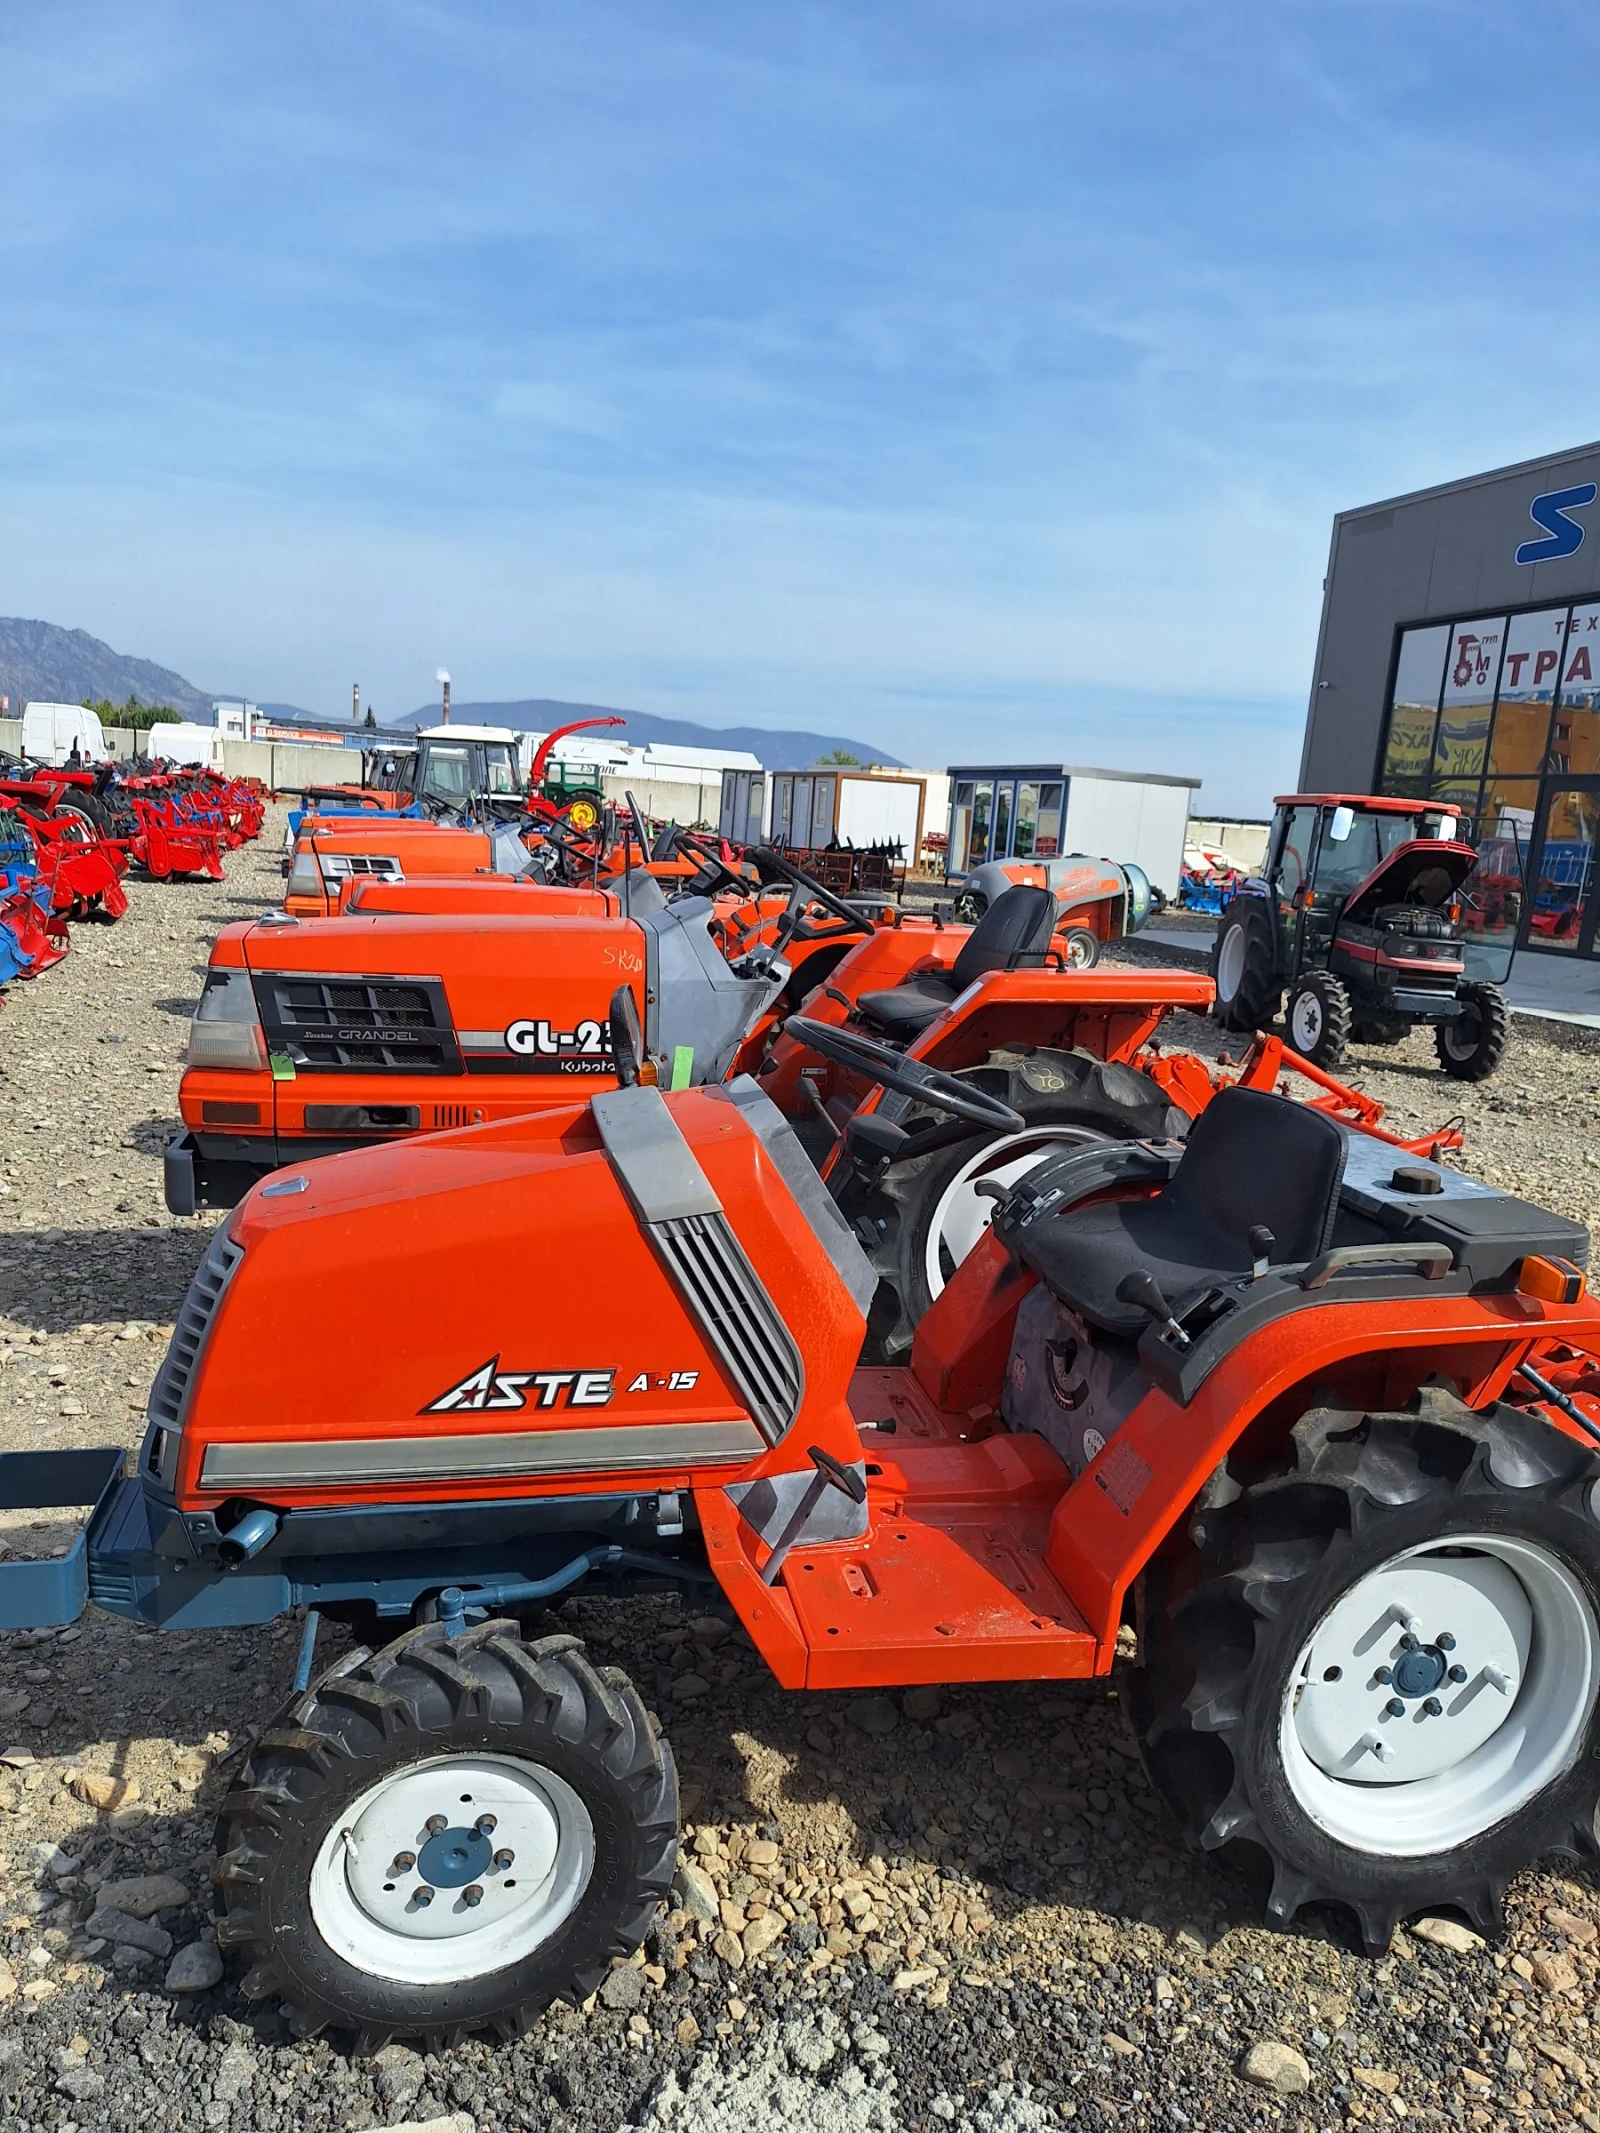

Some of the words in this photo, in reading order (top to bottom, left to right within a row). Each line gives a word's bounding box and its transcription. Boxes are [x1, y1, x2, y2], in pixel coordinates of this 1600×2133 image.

[1506, 646, 1593, 687] ТРА
[338, 1029, 420, 1042] GRANDEL
[560, 1060, 616, 1073] Kubota
[415, 1352, 617, 1416] ASTE
